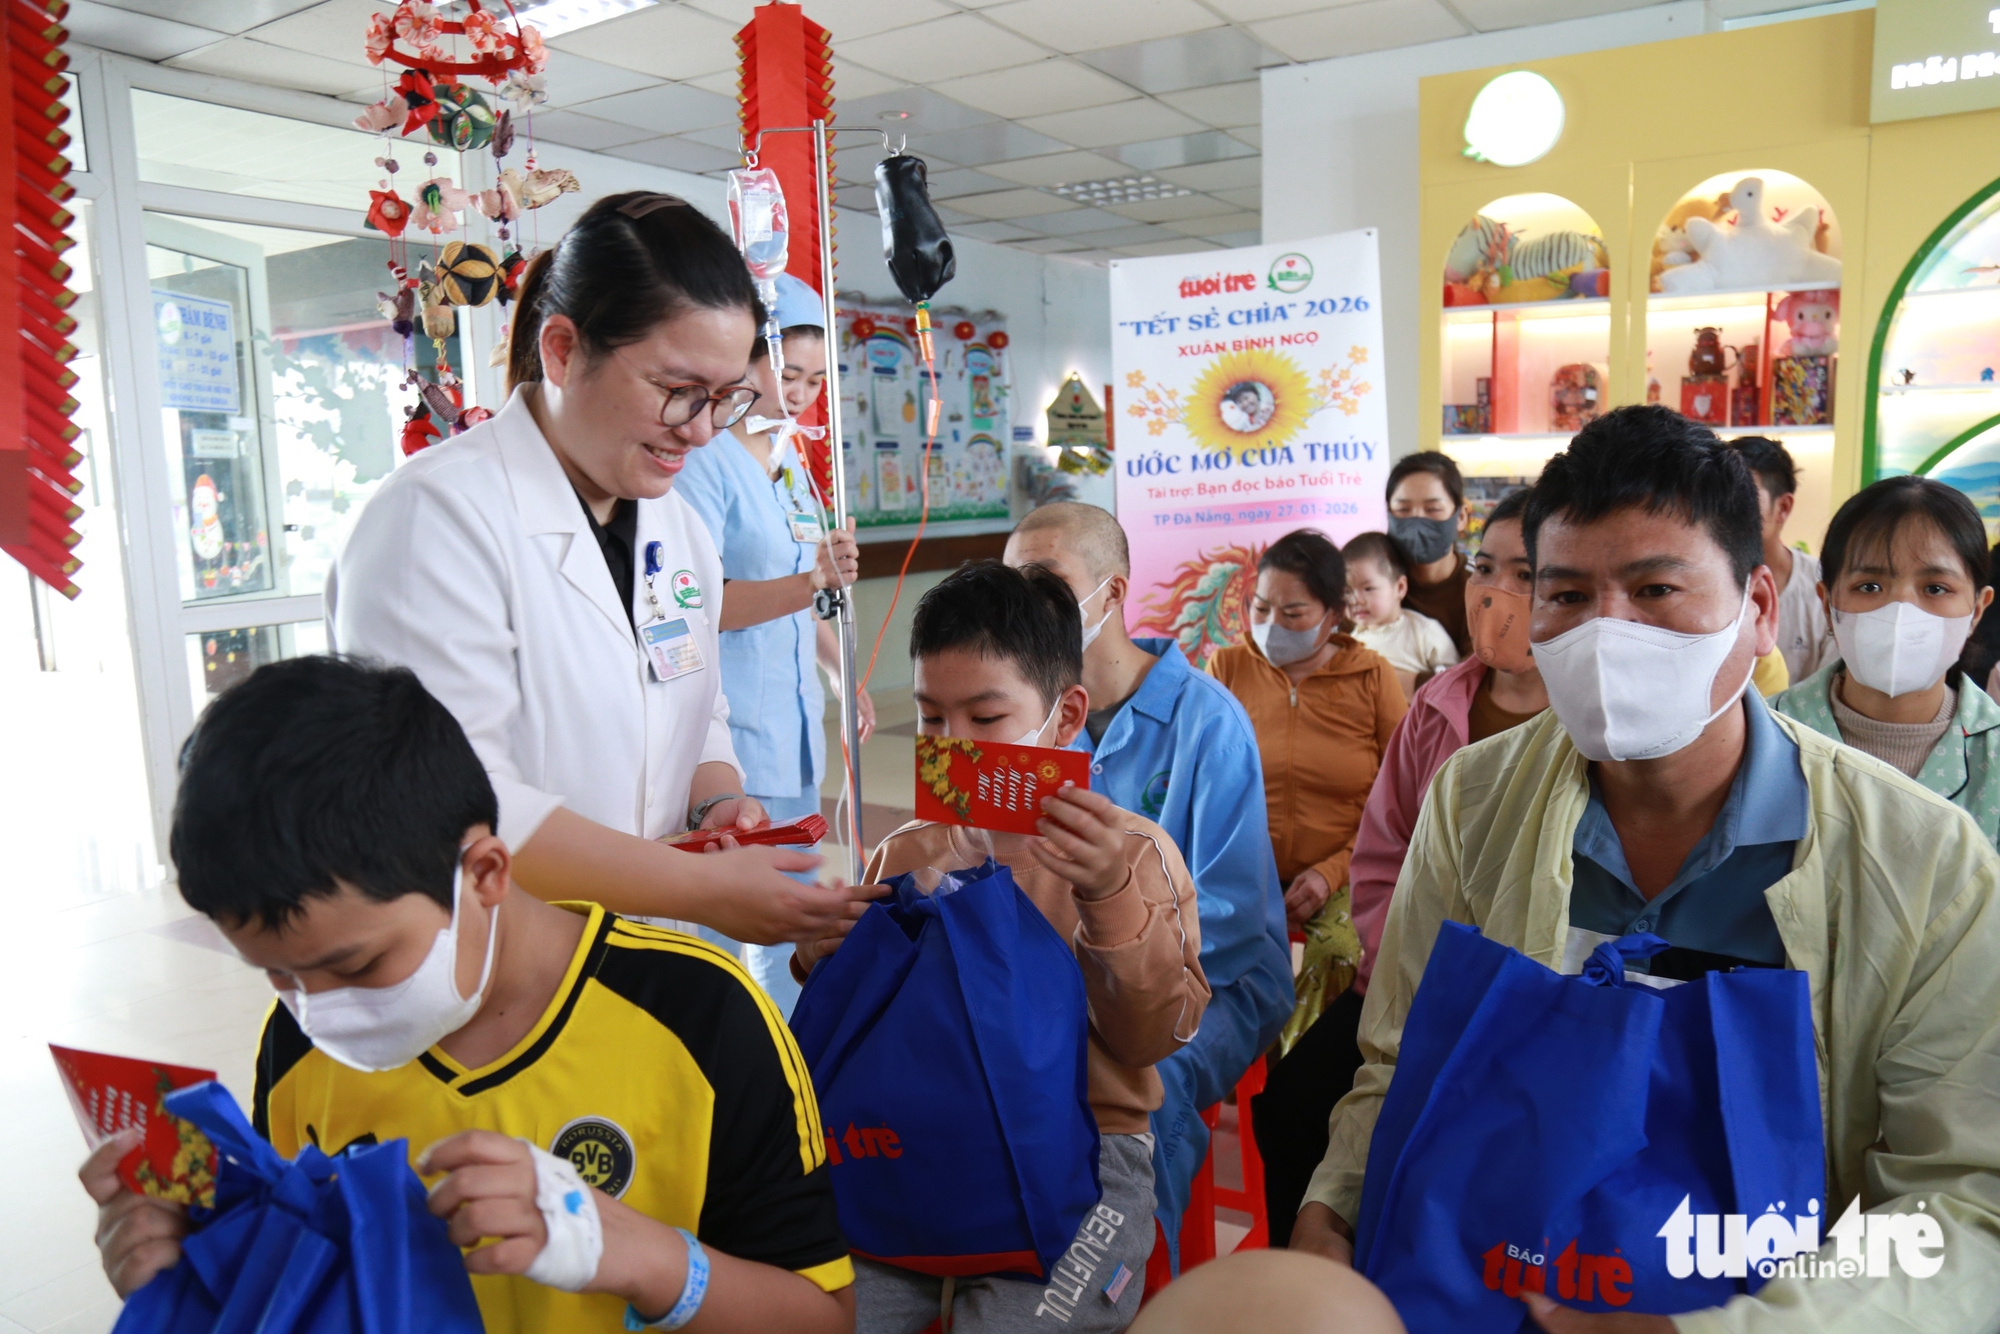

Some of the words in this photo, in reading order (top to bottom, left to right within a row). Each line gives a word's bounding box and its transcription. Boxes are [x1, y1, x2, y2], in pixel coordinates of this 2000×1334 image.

[1188, 306, 1220, 331] SẺ
[1305, 296, 1370, 318] 2026
[1178, 339, 1227, 358] XUÂN
[1232, 333, 1275, 352] BÍNH
[1280, 331, 1319, 347] NGỌ
[1126, 450, 1182, 478] ƯỚC
[1191, 445, 1233, 474] MƠ
[1241, 440, 1295, 468] CỦA
[1303, 435, 1378, 463] THÚY
[1197, 482, 1227, 499] Bạn
[1231, 478, 1260, 496] đọc
[1265, 474, 1296, 490] báo
[1299, 469, 1334, 487] Tuổi
[1338, 470, 1362, 486] Trẻ
[1154, 514, 1171, 527] TP
[1174, 511, 1192, 526] Đà
[1238, 508, 1272, 523] ngày
[978, 768, 991, 802] Mới
[993, 766, 1006, 808] Năm
[1006, 764, 1022, 812] Mừng
[1024, 772, 1038, 811] Chúc
[561, 1126, 624, 1152] BORUSSIA
[842, 1121, 903, 1160] trẻ
[571, 1143, 613, 1175] BVB
[1034, 1203, 1126, 1323] BEAUFITUL
[1508, 1243, 1545, 1266] BÁO
[1552, 1237, 1634, 1307] trẻ
